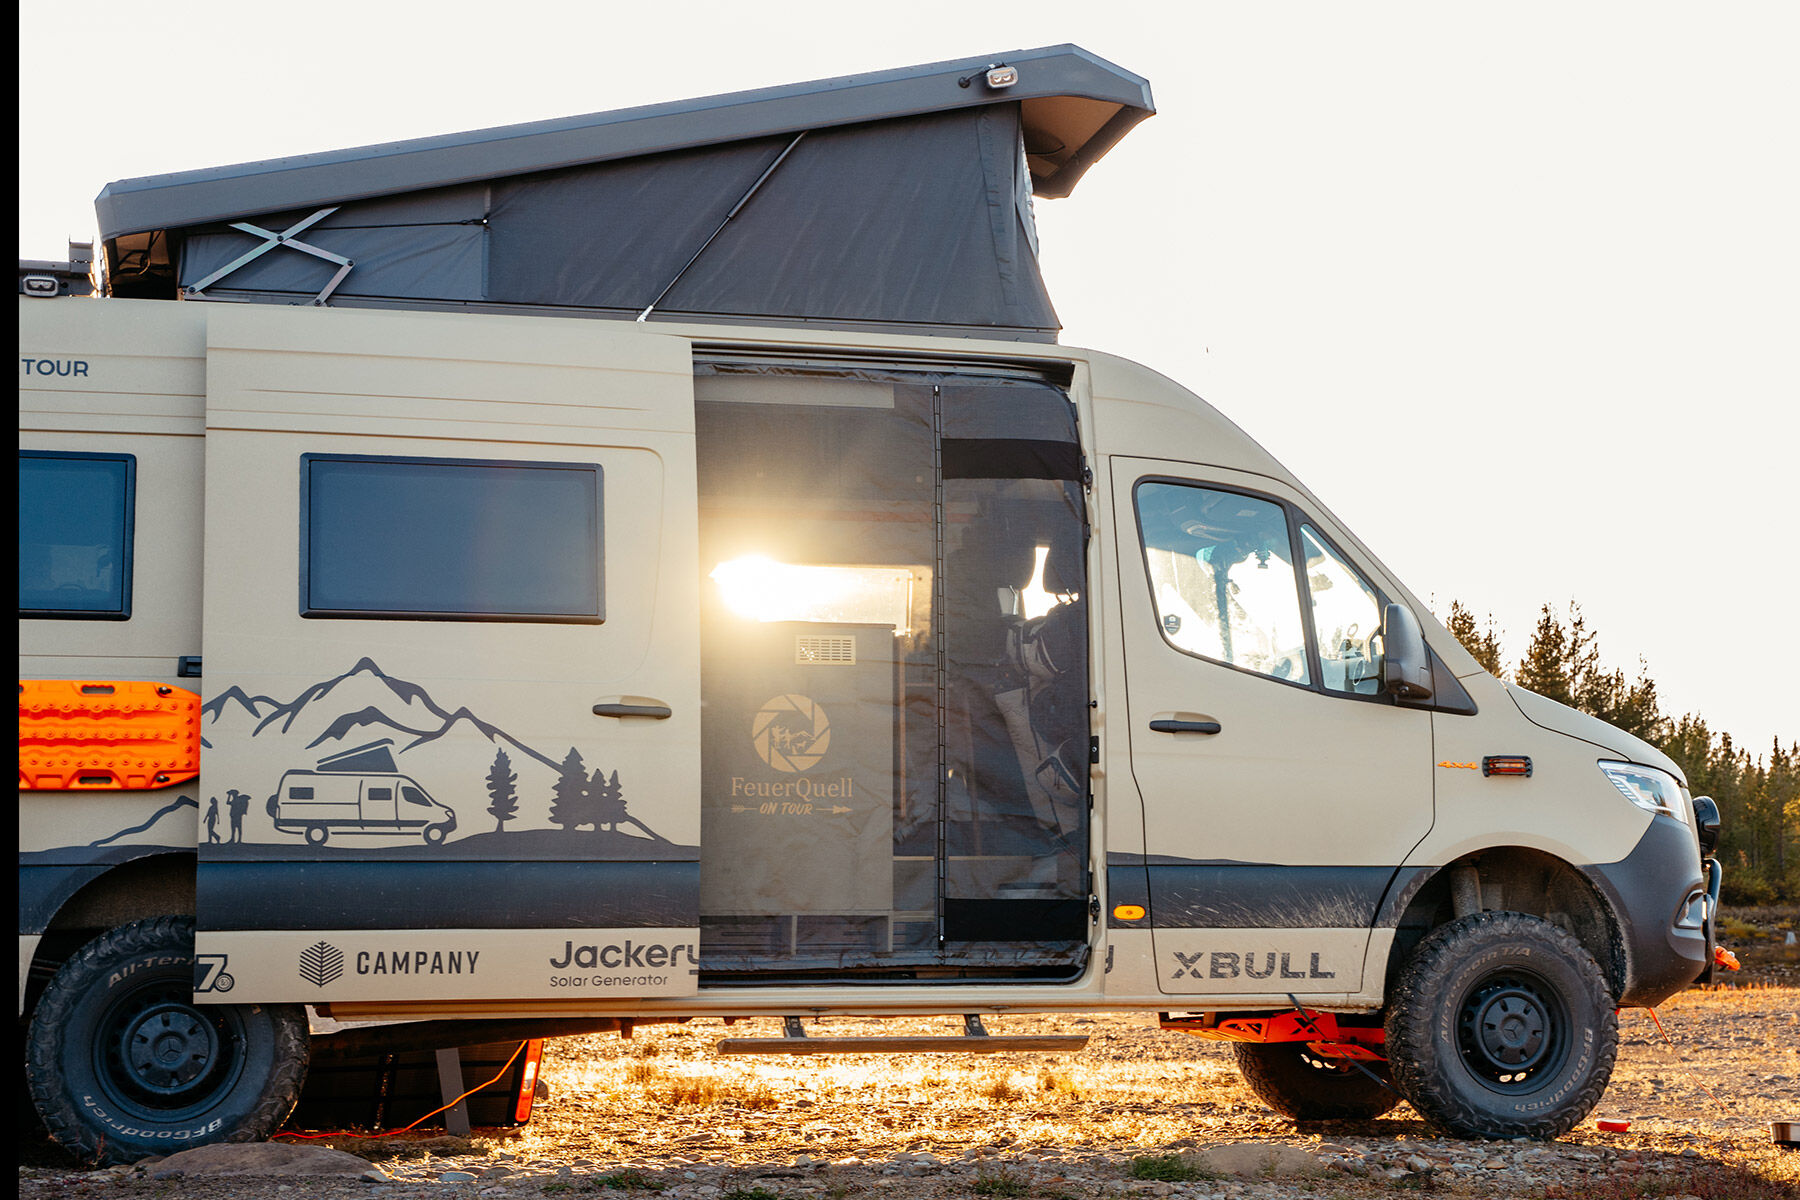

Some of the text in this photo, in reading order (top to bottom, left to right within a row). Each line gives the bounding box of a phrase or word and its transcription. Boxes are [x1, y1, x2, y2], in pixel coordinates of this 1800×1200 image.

[21, 358, 89, 377] TOUR
[1437, 760, 1479, 770] 4x4
[731, 776, 853, 801] FeuerQuell
[760, 802, 813, 815] ON TOUR
[356, 951, 480, 975] CAMPANY
[1171, 951, 1336, 979] XBULL
[549, 974, 669, 988] Solar Generator
[83, 1095, 223, 1141] BFGoodrich
